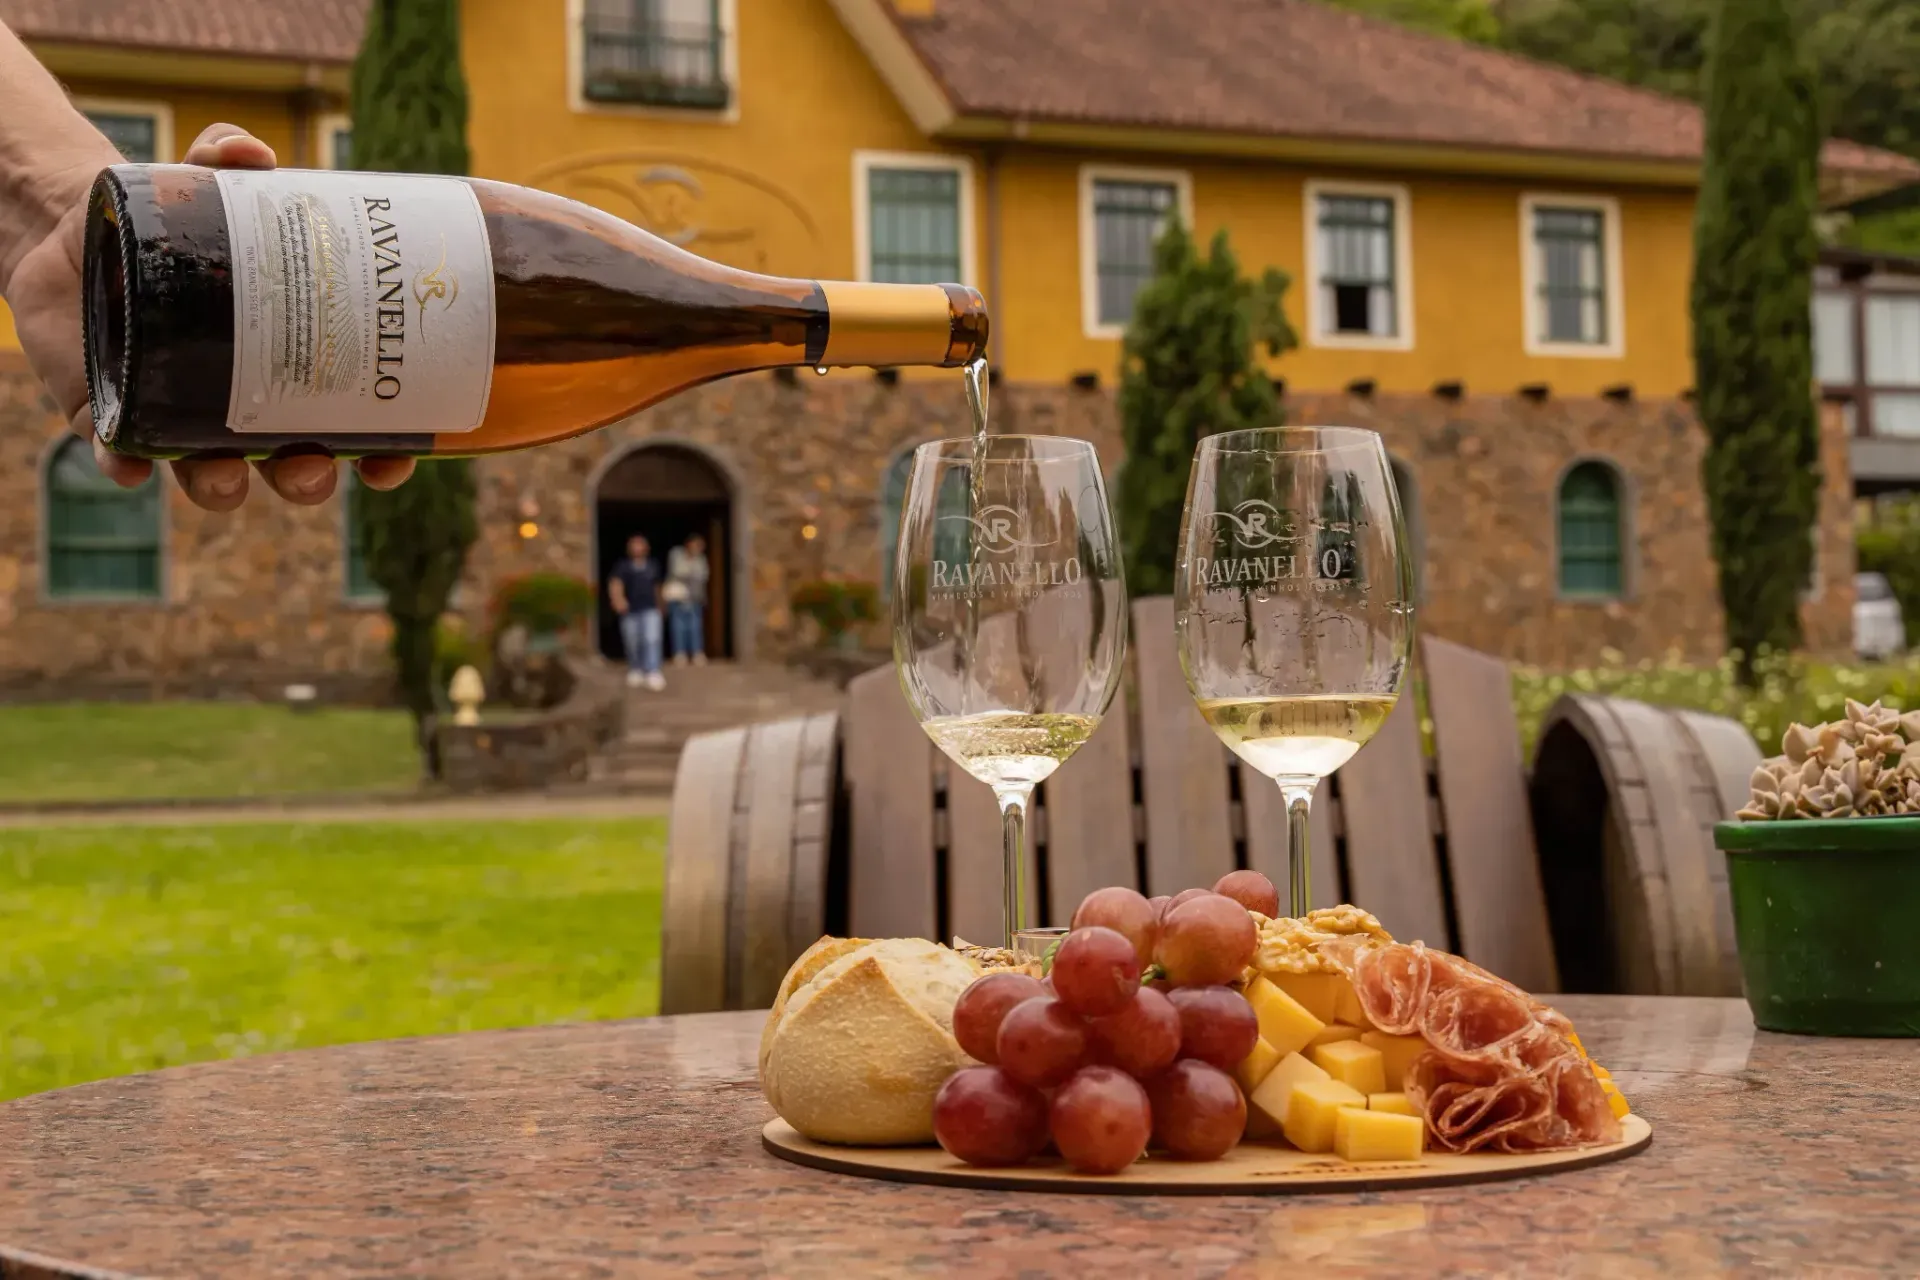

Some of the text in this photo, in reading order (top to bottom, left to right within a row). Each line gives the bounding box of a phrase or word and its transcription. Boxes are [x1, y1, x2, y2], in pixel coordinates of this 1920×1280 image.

[361, 262, 369, 308] ENCOSTAS
[364, 197, 404, 400] RAVANELLO
[364, 312, 370, 323] DE
[932, 557, 1081, 588] RAVANELLO
[1195, 549, 1341, 586] RAVANELLO
